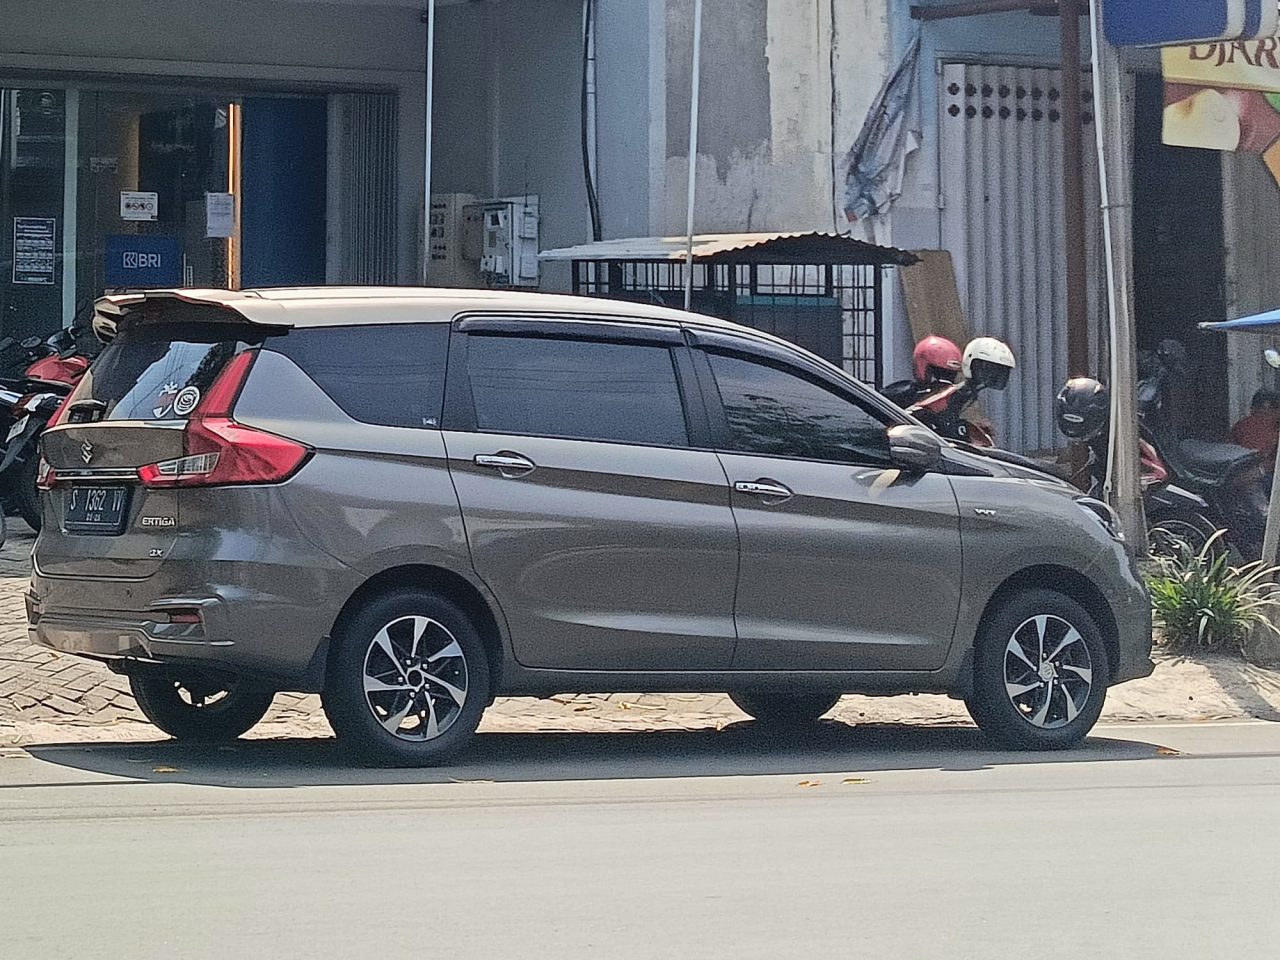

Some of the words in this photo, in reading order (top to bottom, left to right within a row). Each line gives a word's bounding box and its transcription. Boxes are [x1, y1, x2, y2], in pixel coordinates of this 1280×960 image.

[1188, 35, 1280, 69] JAR
[138, 253, 161, 268] BRI
[70, 489, 78, 510] S
[142, 516, 175, 526] ERTIGA
